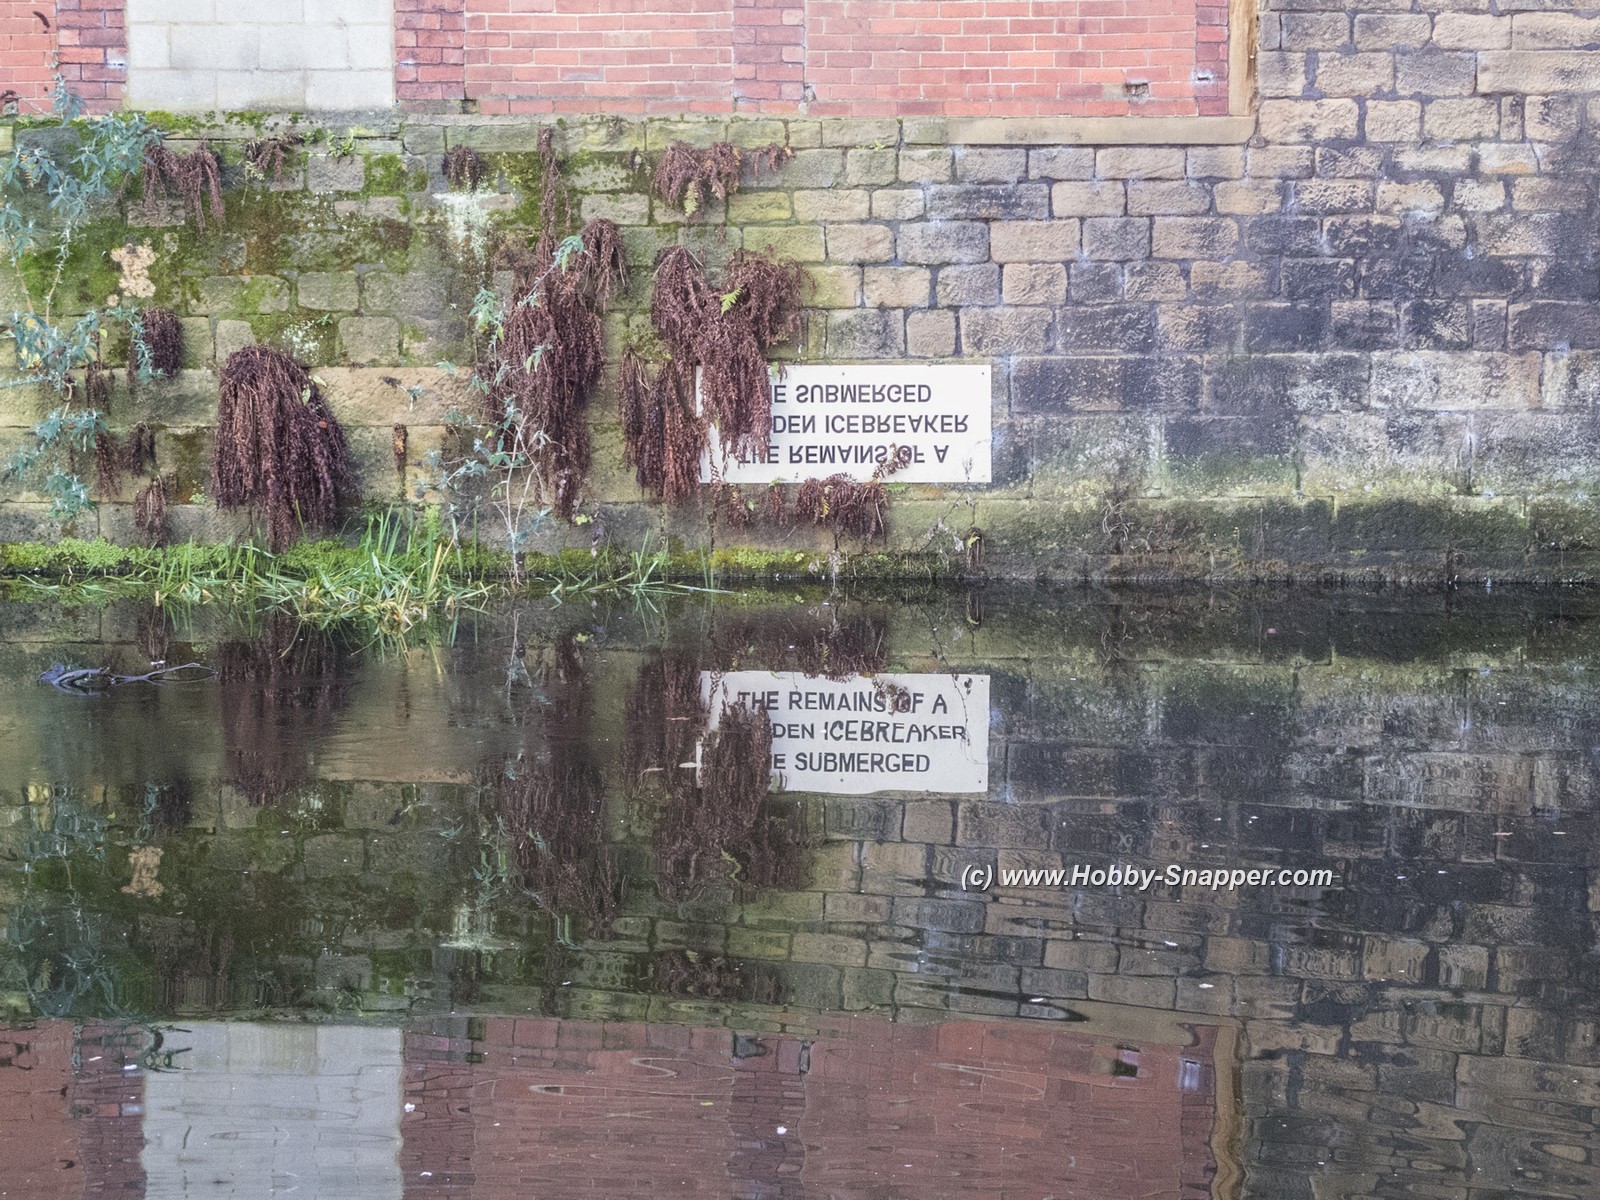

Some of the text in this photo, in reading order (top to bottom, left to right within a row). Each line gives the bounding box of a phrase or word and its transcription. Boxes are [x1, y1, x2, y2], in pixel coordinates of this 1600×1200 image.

[738, 690, 948, 715] THE REMAINS OF A
[772, 719, 967, 744] DEN ICEBREAKER
[794, 751, 931, 773] SUBMERGED
